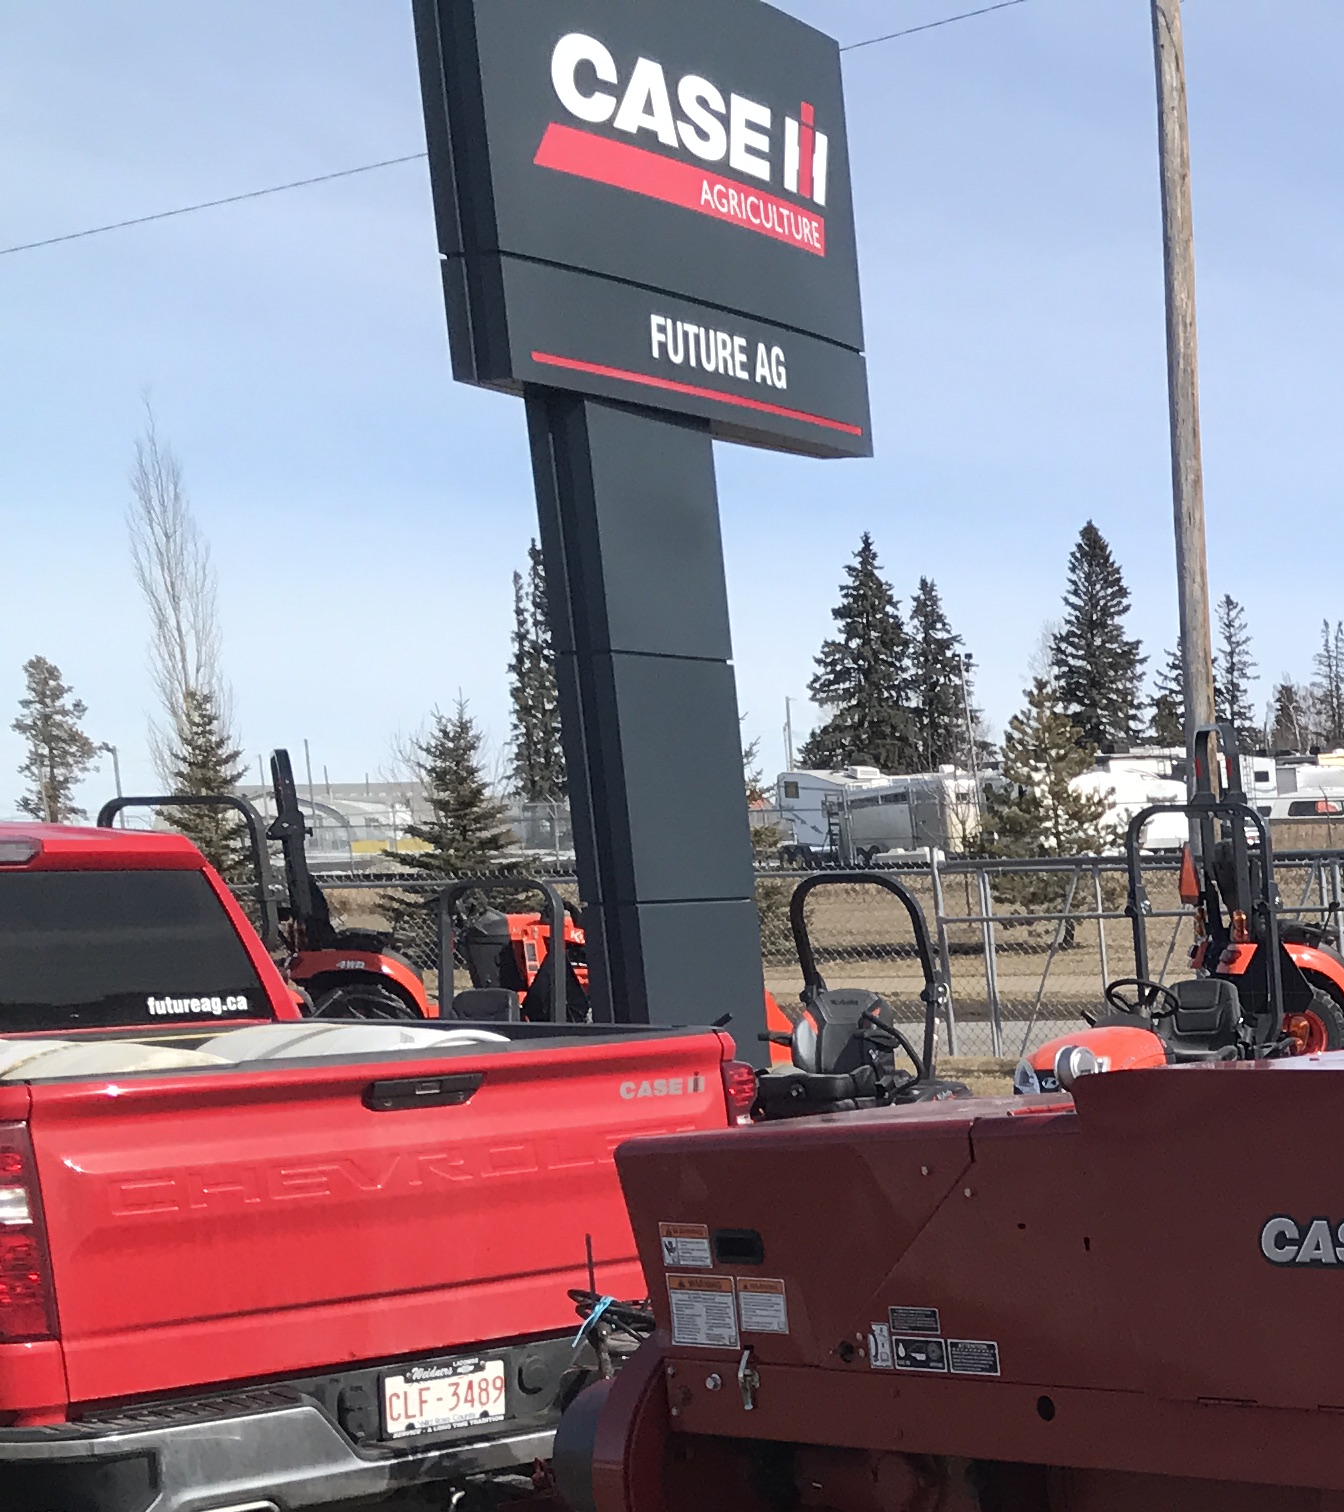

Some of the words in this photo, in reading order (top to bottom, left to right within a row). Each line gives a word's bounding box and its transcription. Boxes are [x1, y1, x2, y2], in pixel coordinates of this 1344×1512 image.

[551, 33, 772, 182] CASE
[701, 180, 821, 248] AGRICULTURE
[651, 314, 749, 380] FUTURE
[755, 342, 787, 389] AG
[147, 995, 248, 1015] futureag.ca
[620, 1078, 683, 1100] CASE
[111, 1126, 698, 1216] CHEVROL
[388, 1376, 504, 1421] CLF-3489
